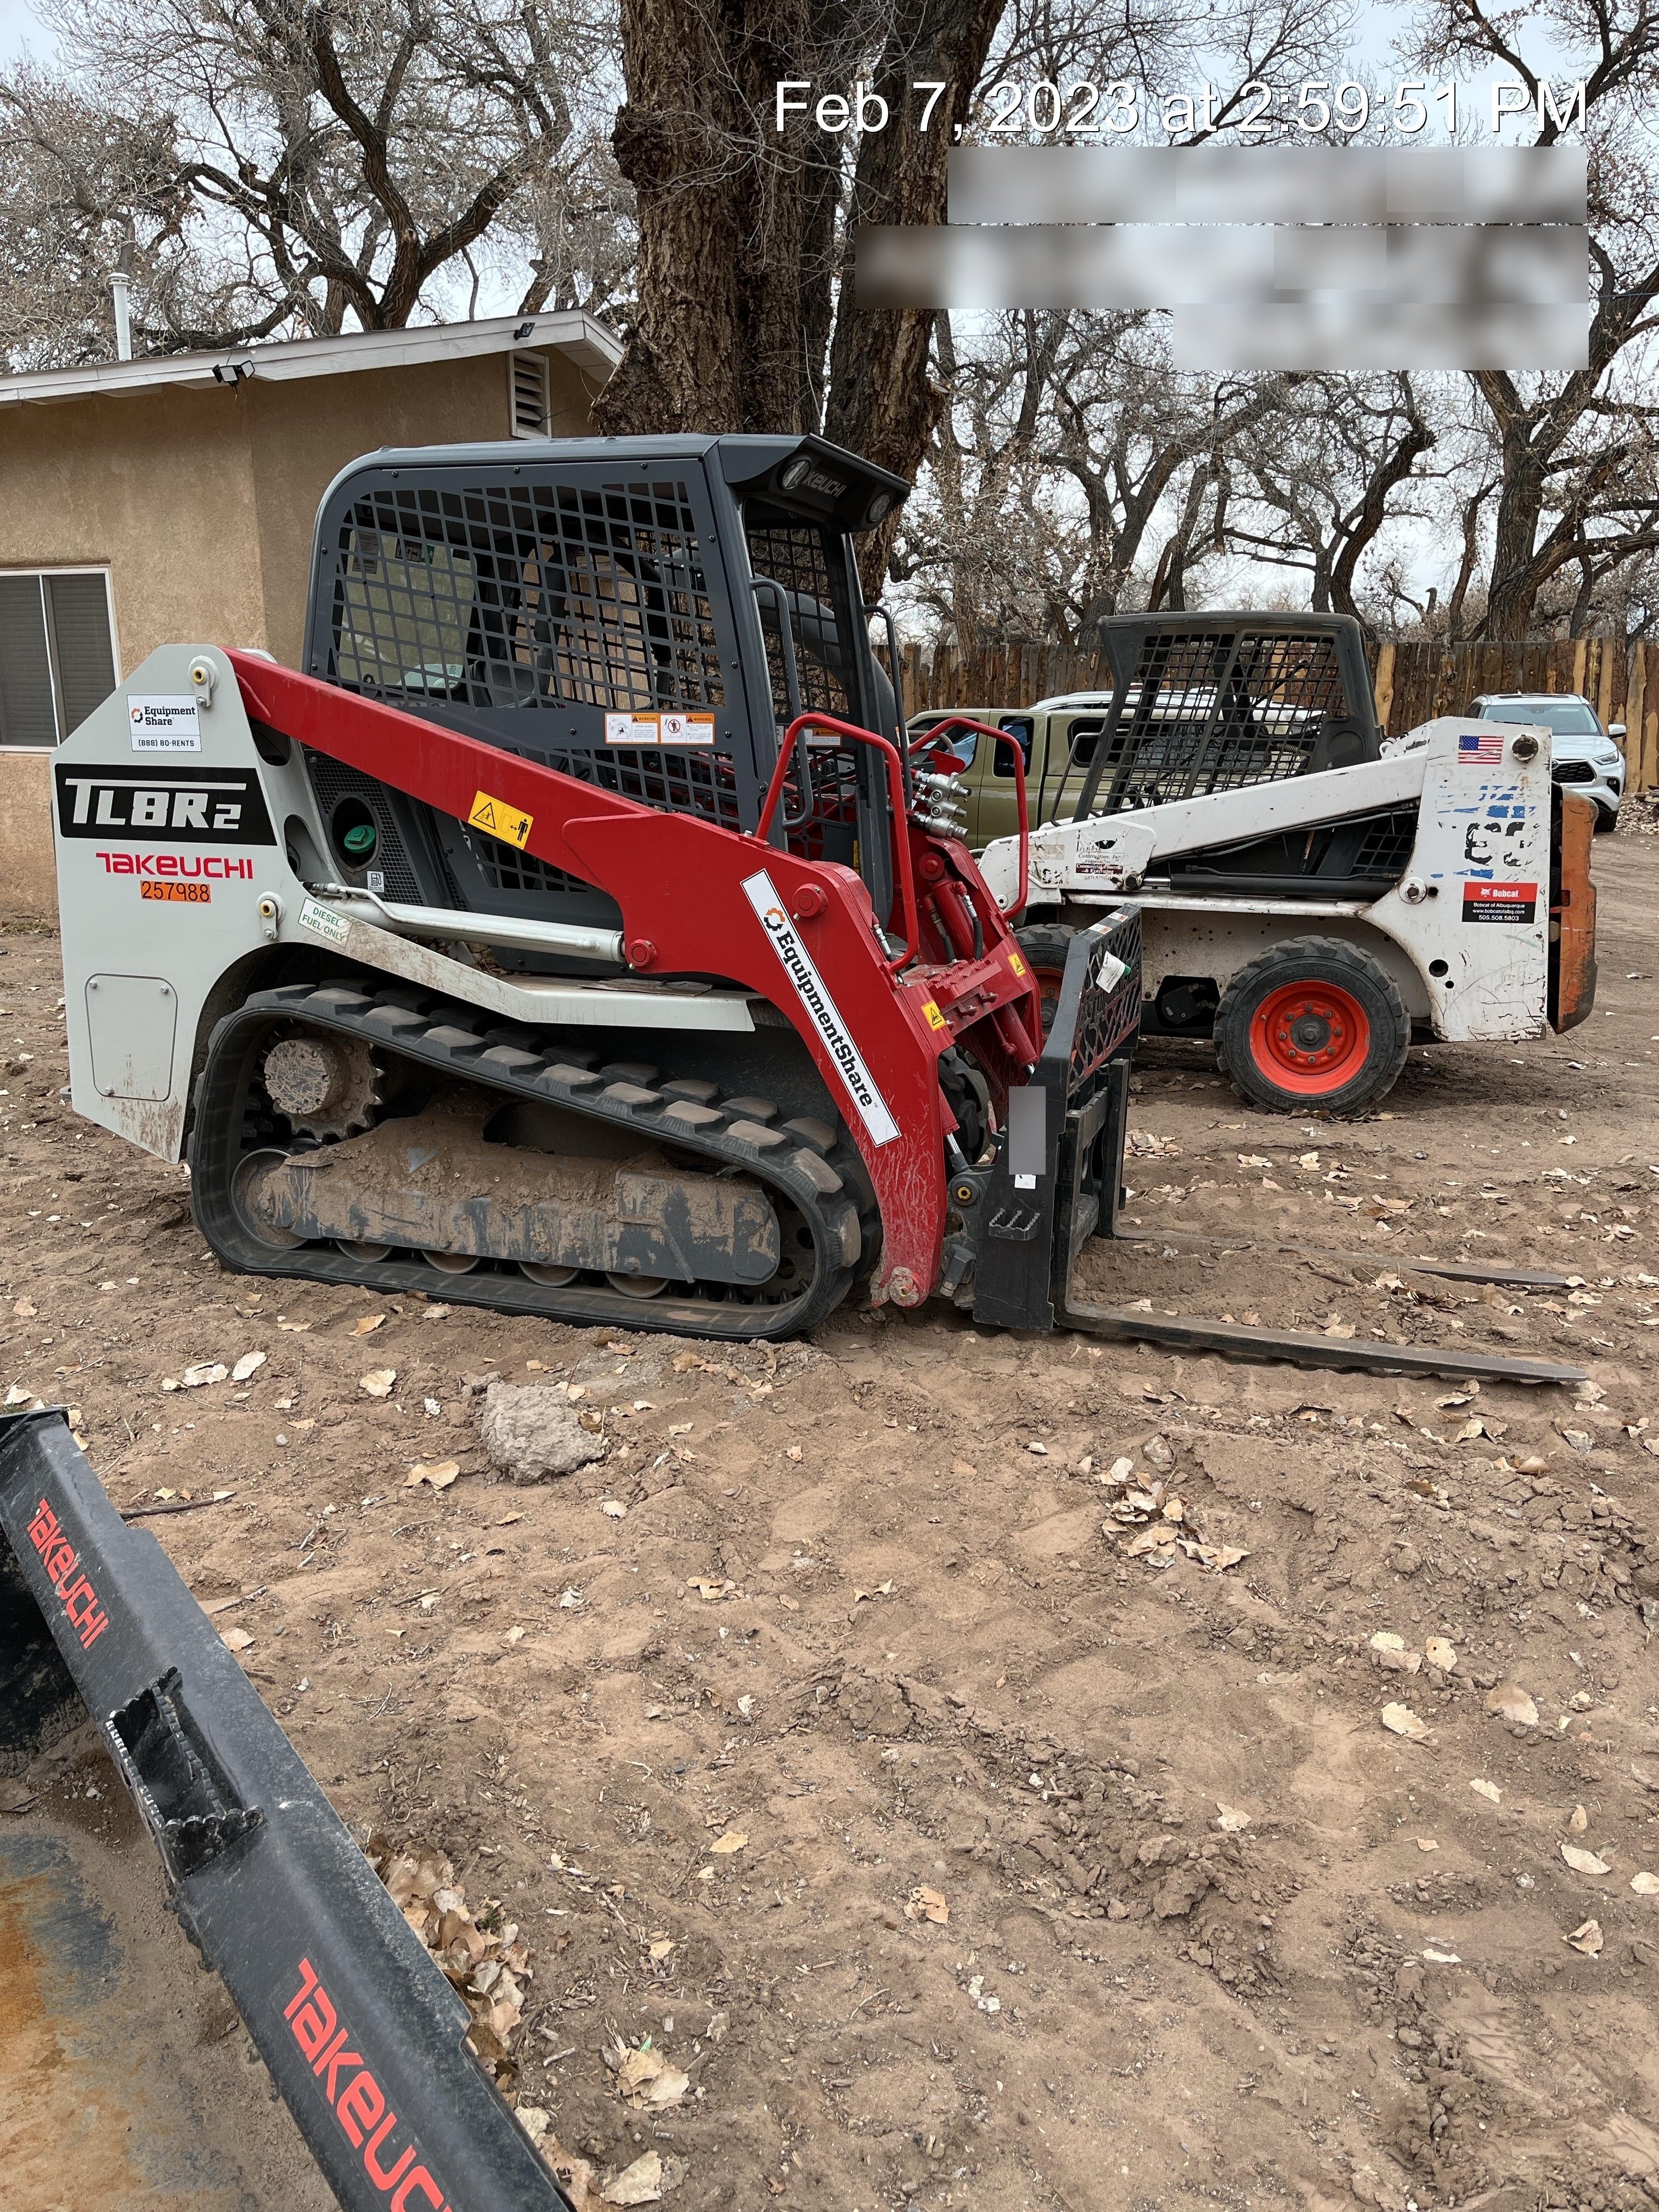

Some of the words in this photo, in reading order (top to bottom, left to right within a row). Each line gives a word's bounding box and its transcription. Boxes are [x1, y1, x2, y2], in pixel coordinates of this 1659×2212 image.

[144, 706, 196, 717] Equipment
[145, 716, 173, 726] Share
[96, 852, 254, 879] TAKEUCHI
[142, 881, 210, 902] 257988
[1492, 889, 1519, 898] Bobcat
[313, 906, 340, 928] DIESEL
[302, 914, 321, 930] FUEL
[324, 926, 346, 942] ONLY
[776, 930, 873, 1107] EquipmentShare
